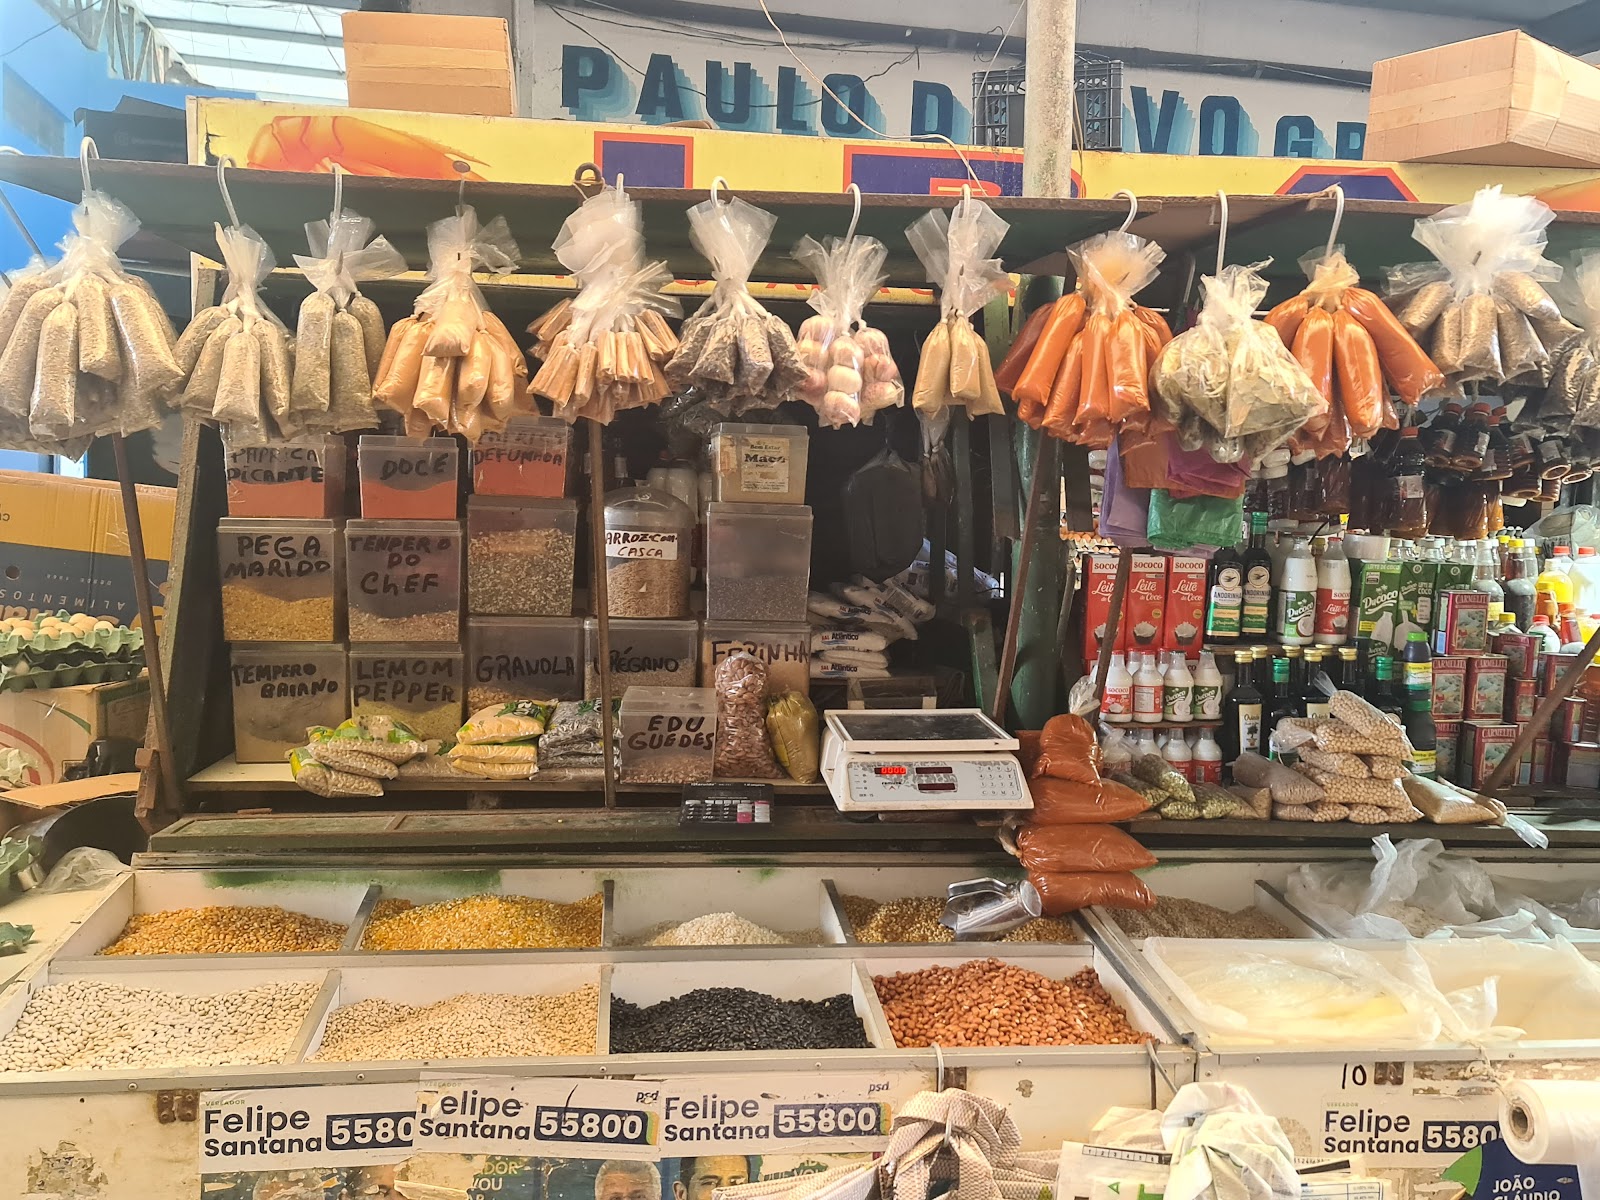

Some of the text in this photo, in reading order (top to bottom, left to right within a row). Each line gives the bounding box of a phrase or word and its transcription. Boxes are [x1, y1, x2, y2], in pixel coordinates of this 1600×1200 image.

[562, 45, 880, 138] PAULO
[380, 453, 449, 480] DOCE
[237, 535, 321, 559] PEGA
[618, 547, 663, 558] CASCA
[224, 559, 331, 579] MARIDO
[387, 553, 421, 569] DO
[1133, 561, 1163, 569] SOCOCO
[1174, 561, 1204, 569] SOCOCO
[1131, 579, 1157, 595] Leite
[1172, 579, 1198, 595] Leite
[1363, 590, 1398, 609] Ducoco
[831, 632, 859, 641] Atlântico
[231, 663, 317, 687] TEMPERO
[476, 654, 575, 683] GRANOLA
[831, 663, 858, 672] Atlântico
[261, 678, 339, 699] BAIANO
[354, 680, 456, 707] PEPPER
[648, 715, 704, 733] EDU
[628, 732, 715, 751] GUEDES
[1342, 1063, 1367, 1089] 10
[869, 1081, 890, 1096] psd
[420, 1089, 521, 1122] elipe
[665, 1093, 759, 1125] Felipe
[204, 1105, 311, 1138] Felipe
[419, 1110, 643, 1140] Santana 55800
[664, 1108, 876, 1142] Santana 55800
[1325, 1108, 1410, 1138] Felipe
[204, 1116, 416, 1157] Santana 5580
[1324, 1125, 1500, 1154] Santana 5580
[1492, 1174, 1535, 1194] JOÃO
